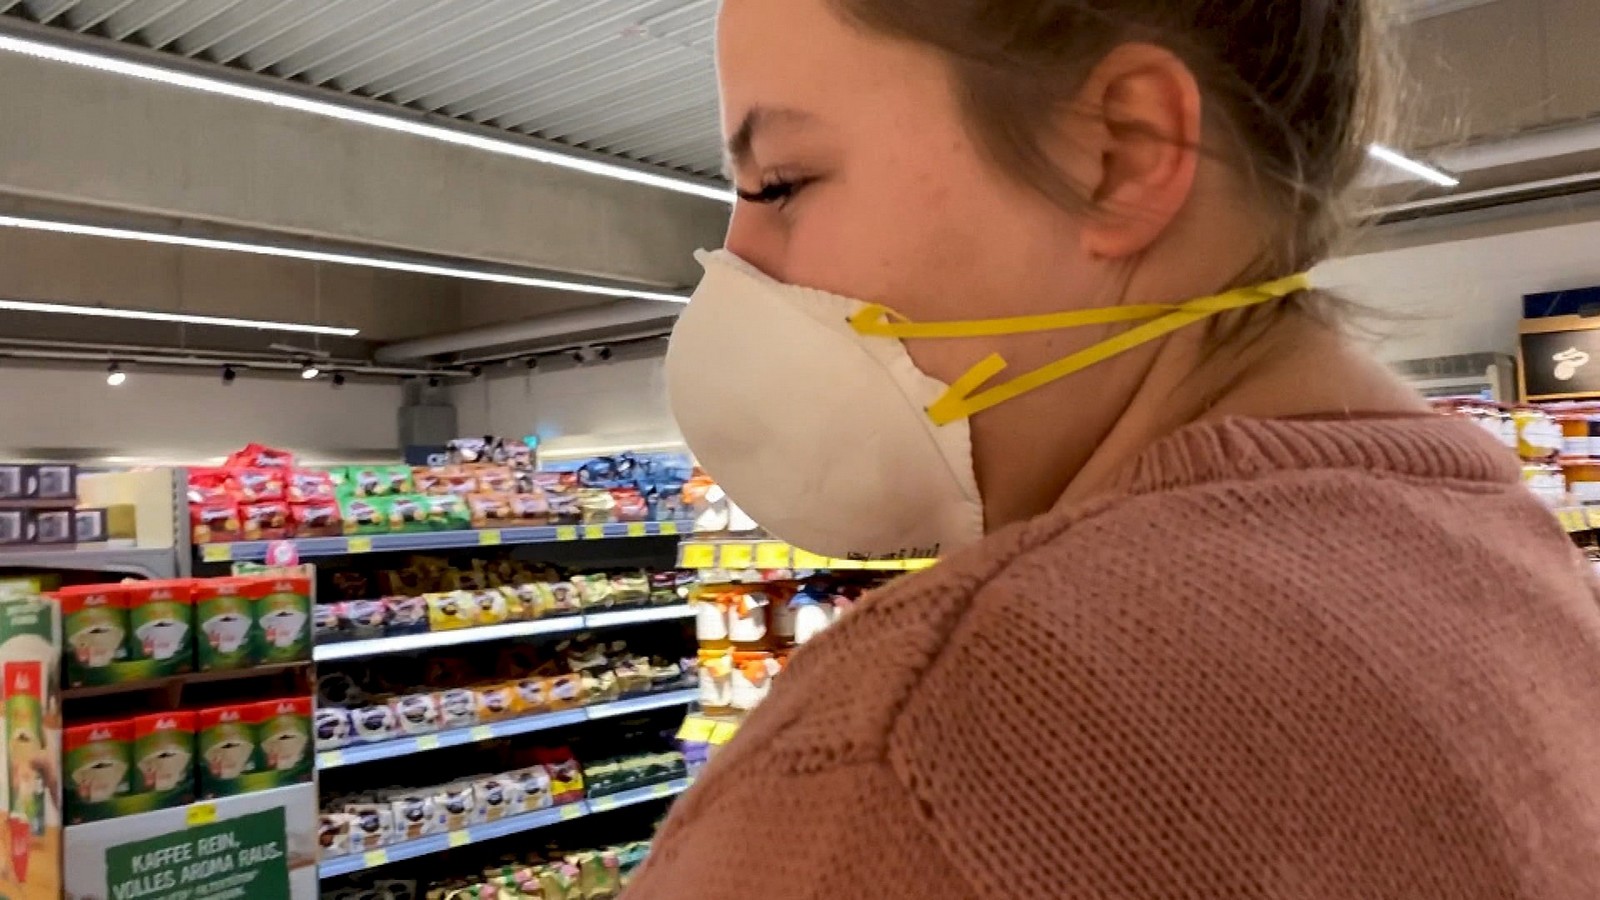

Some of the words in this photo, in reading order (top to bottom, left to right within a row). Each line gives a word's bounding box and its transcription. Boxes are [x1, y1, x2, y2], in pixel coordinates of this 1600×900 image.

[112, 869, 176, 900] VOLLES
[180, 854, 234, 884] AROMA
[132, 842, 193, 874] KAFFEE
